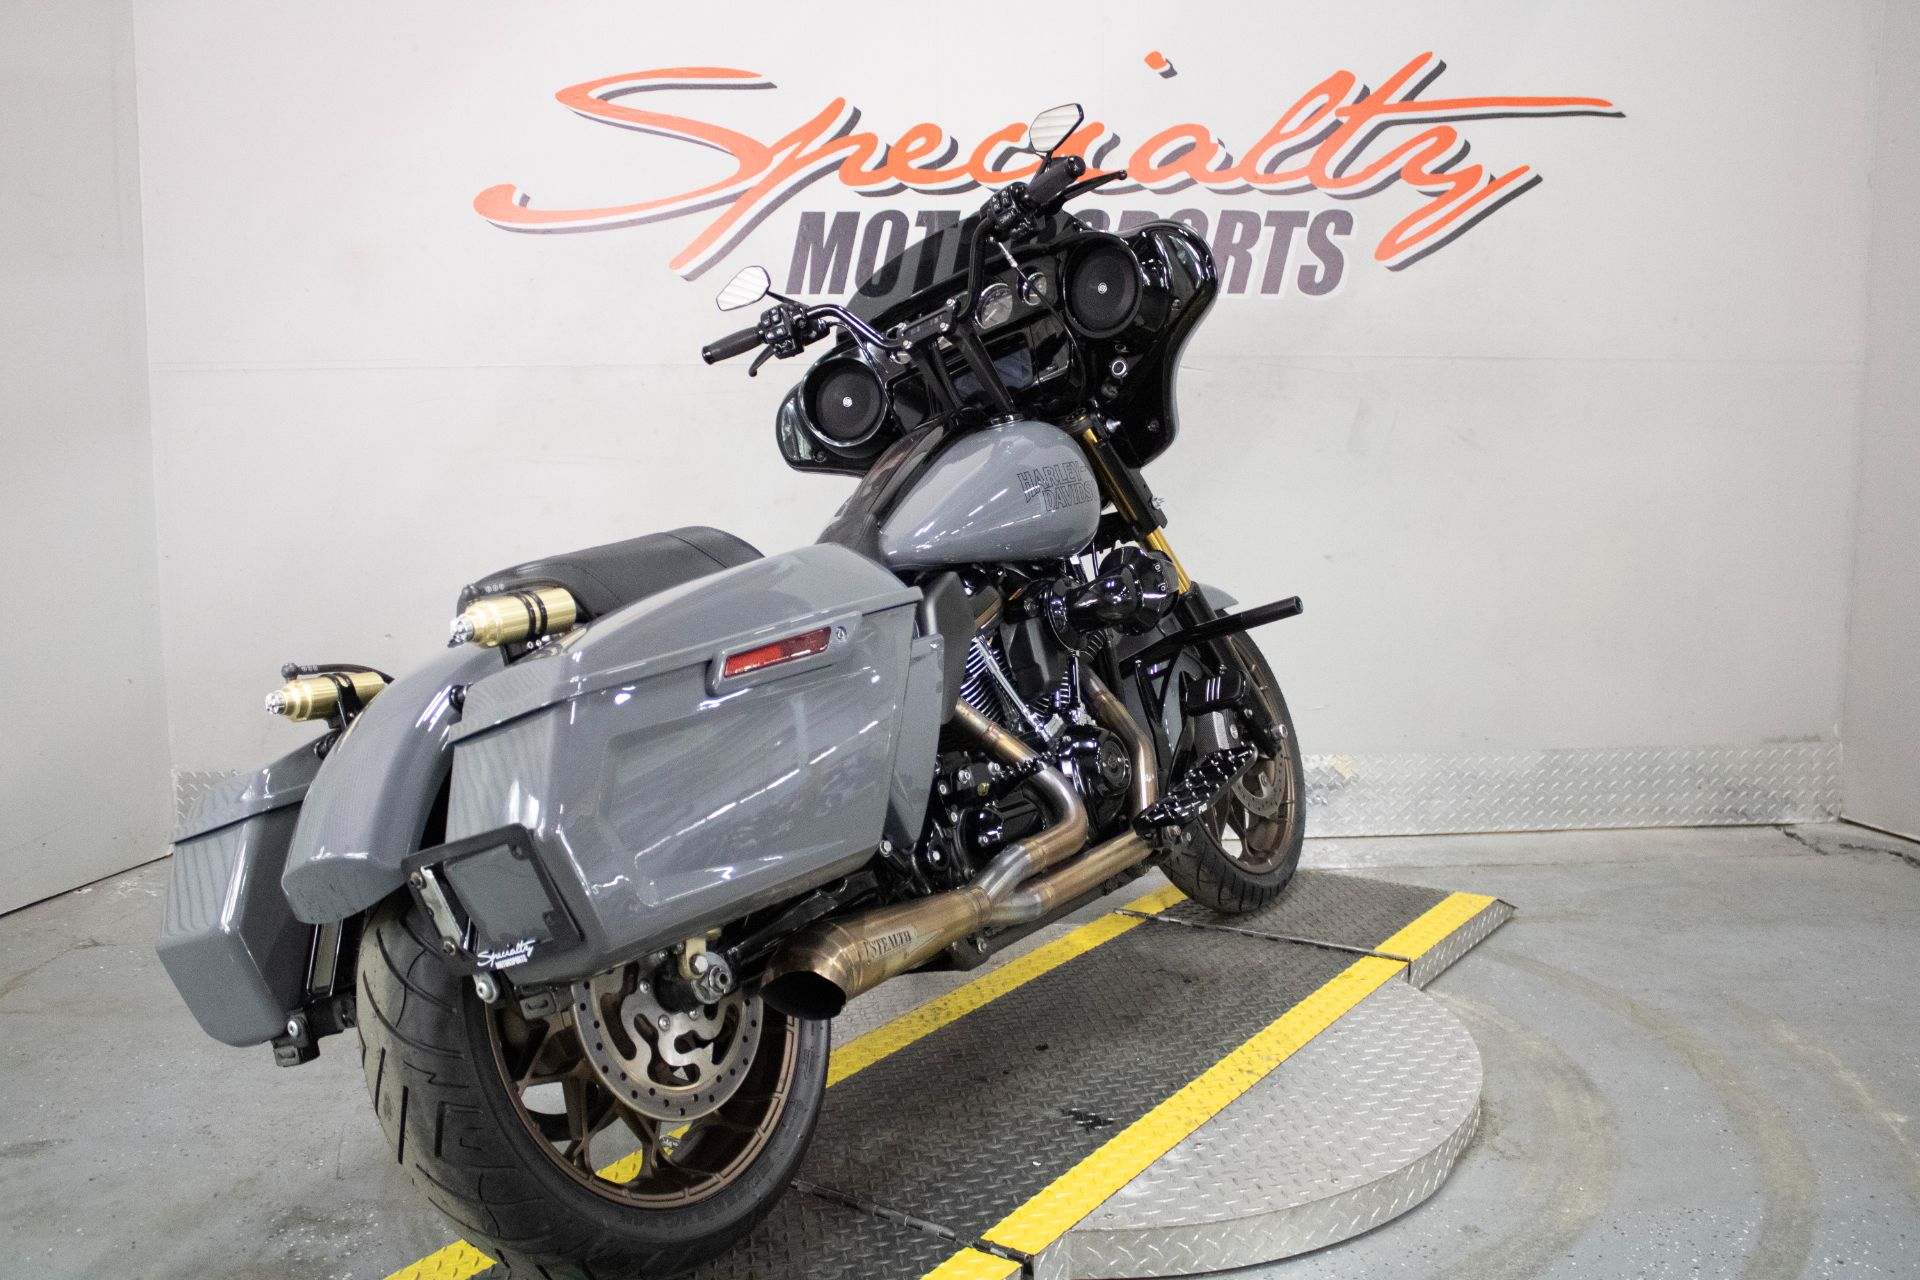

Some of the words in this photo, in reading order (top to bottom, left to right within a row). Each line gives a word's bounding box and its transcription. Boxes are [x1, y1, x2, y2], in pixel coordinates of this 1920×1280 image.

[473, 51, 1626, 281] Specialty
[785, 208, 1353, 297] MOTRTS
[477, 939, 536, 968] Specialty
